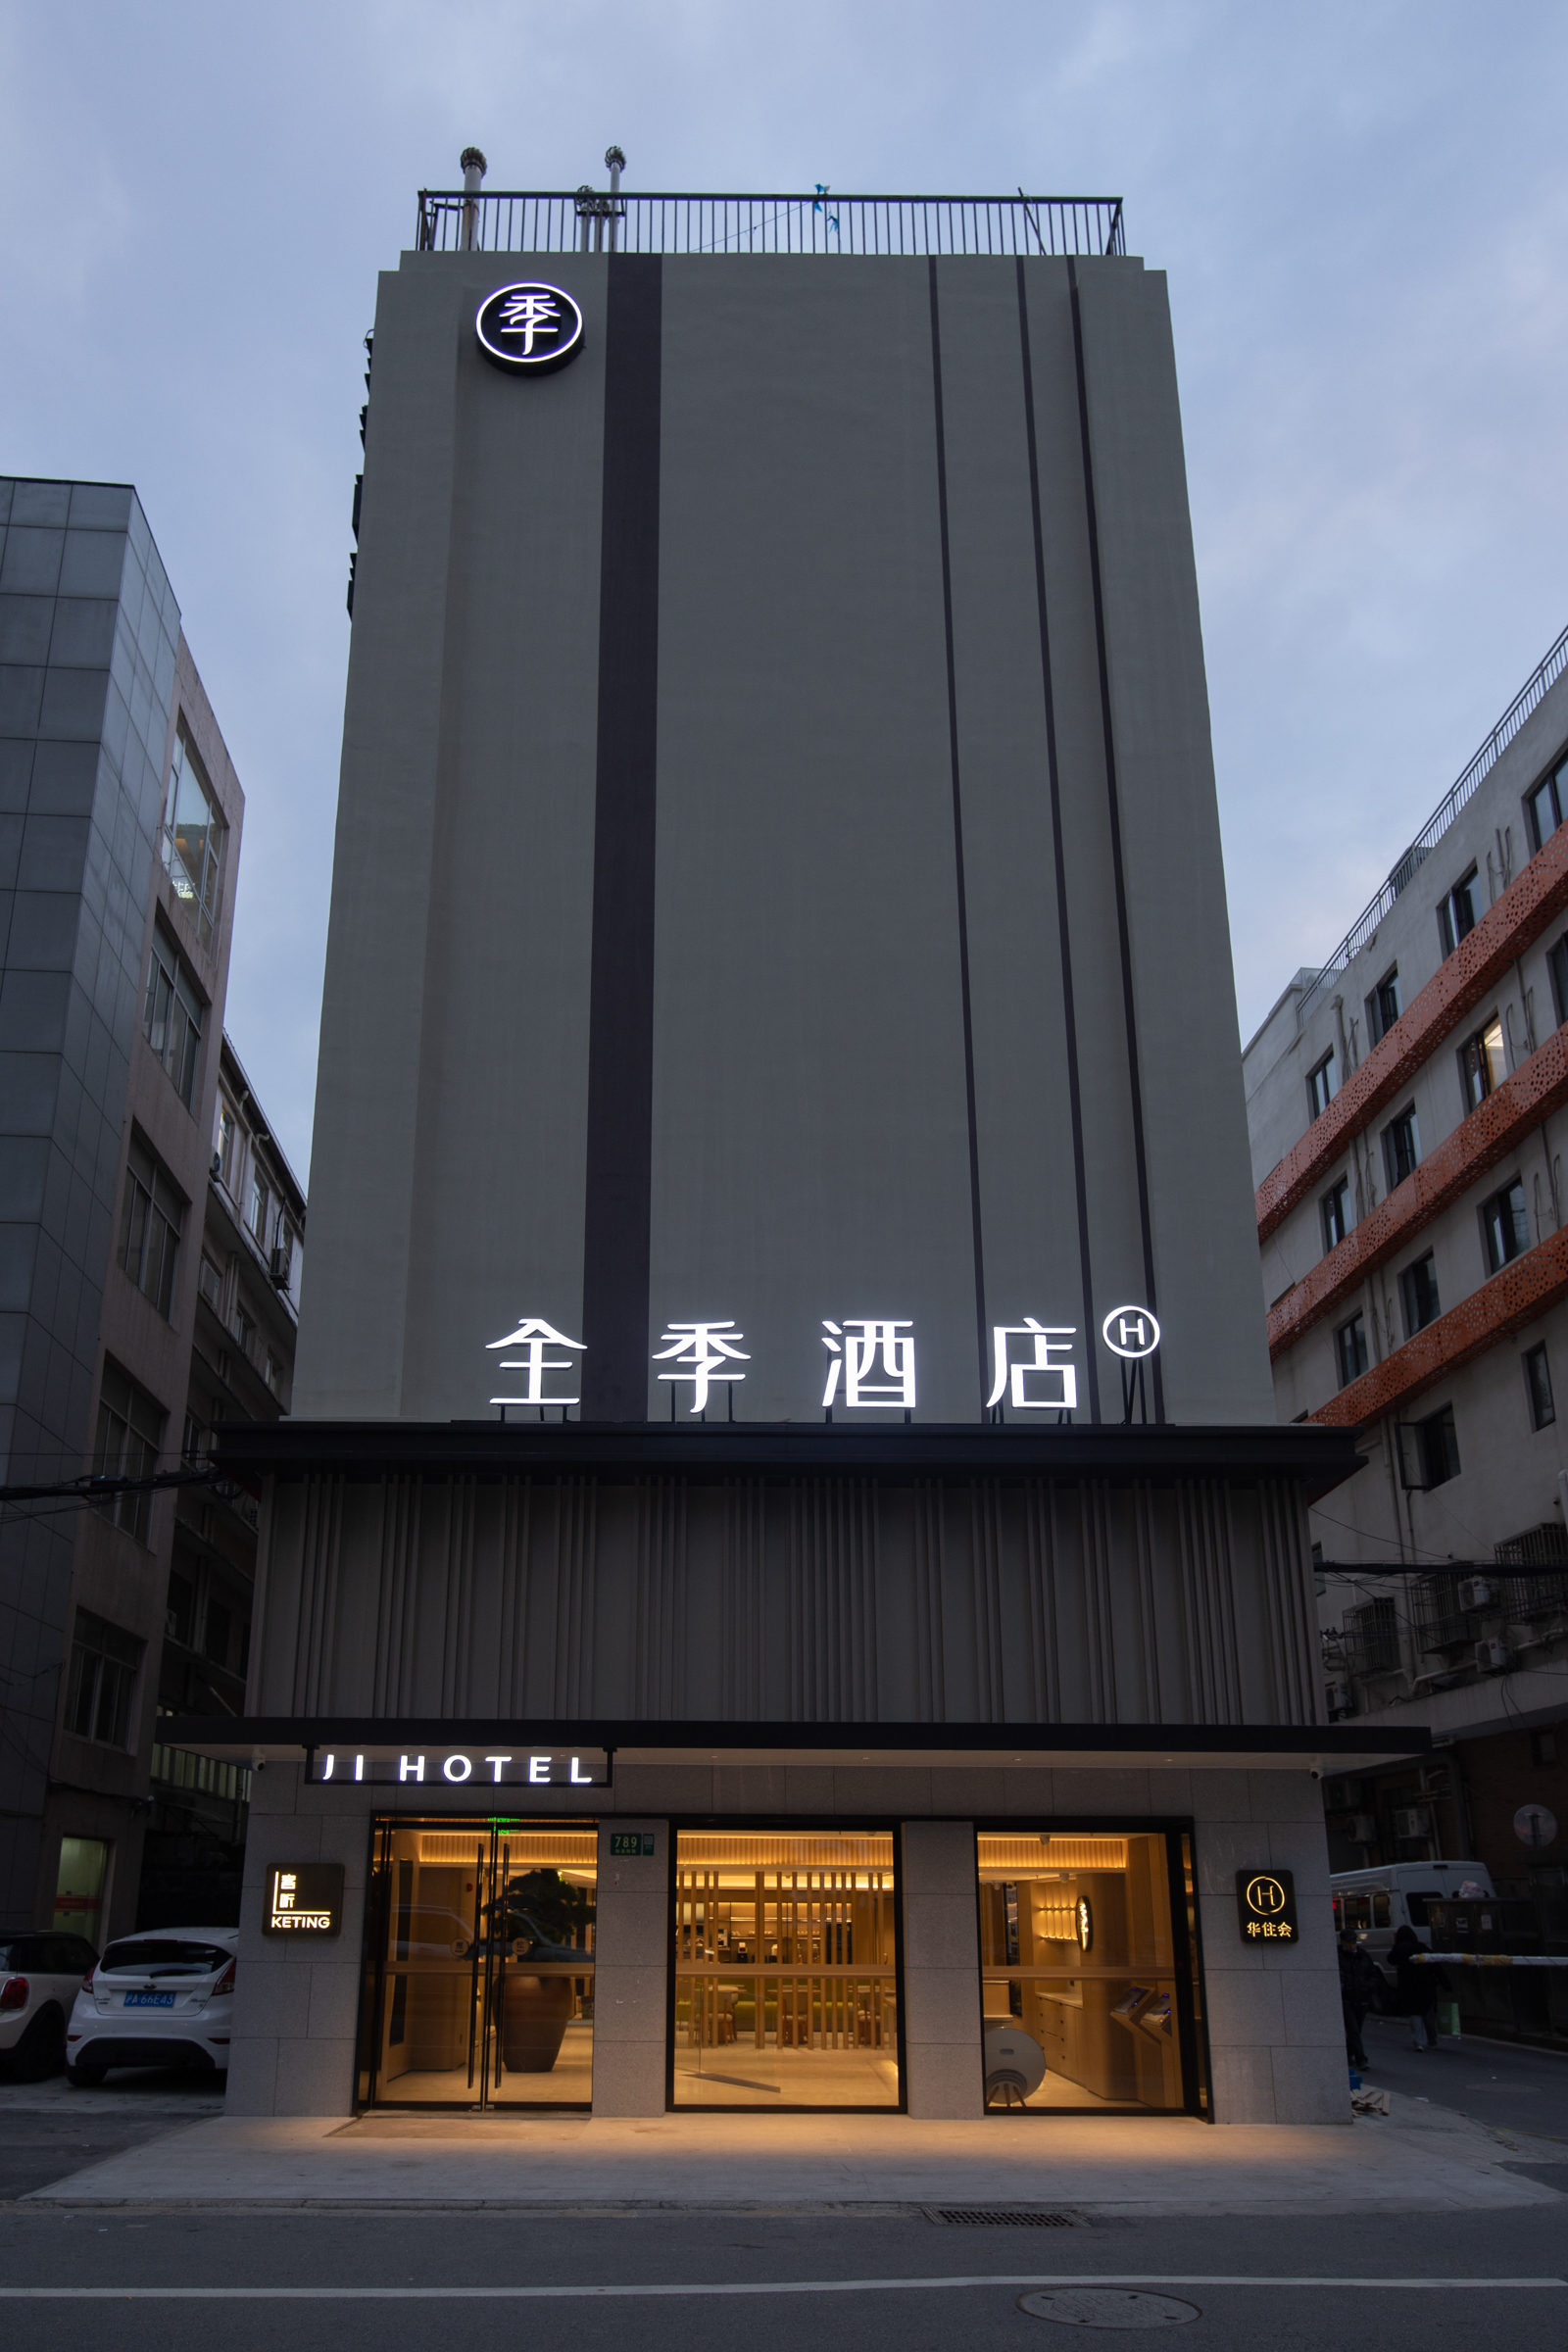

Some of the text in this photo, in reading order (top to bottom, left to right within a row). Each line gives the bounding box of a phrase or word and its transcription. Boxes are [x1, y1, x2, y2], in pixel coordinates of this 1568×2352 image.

[498, 293, 562, 356] 季
[485, 1317, 1078, 1414] 全季酒店
[321, 1754, 592, 1783] JI HOTEL
[614, 1836, 638, 1848] 789
[270, 1916, 331, 1930] KETING
[1247, 1921, 1293, 1937] 华住会
